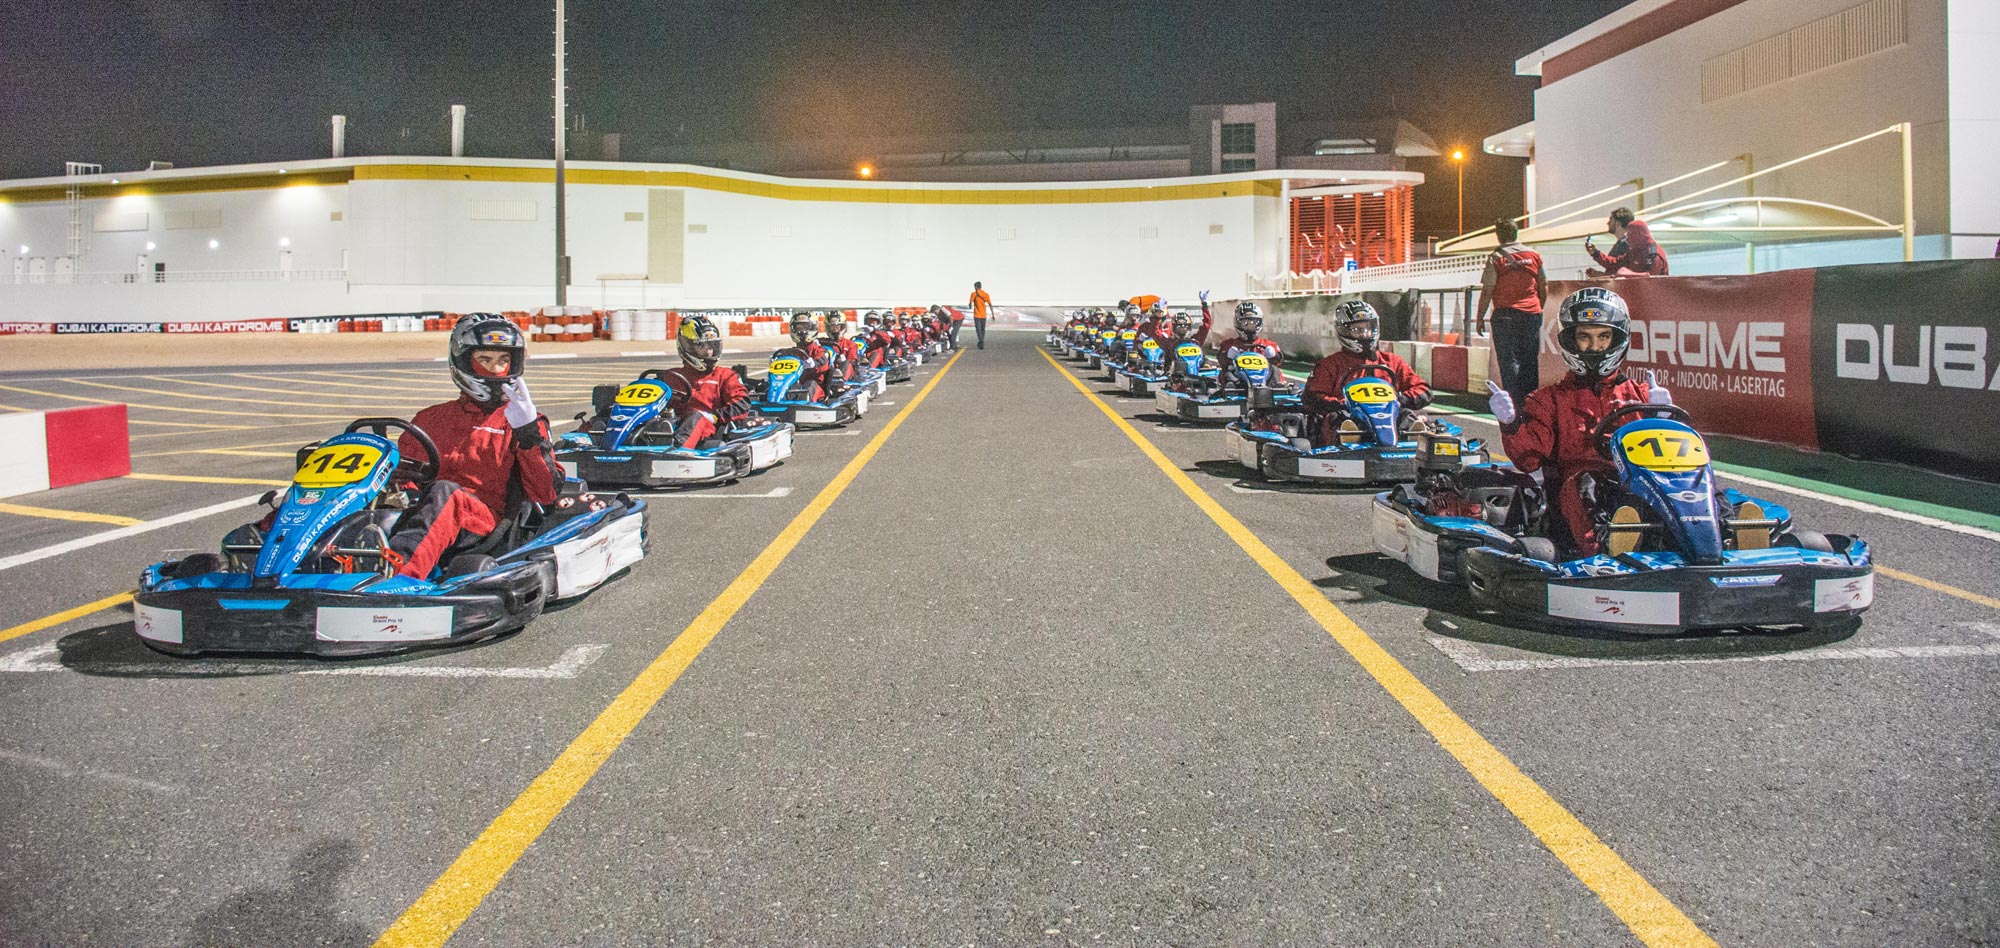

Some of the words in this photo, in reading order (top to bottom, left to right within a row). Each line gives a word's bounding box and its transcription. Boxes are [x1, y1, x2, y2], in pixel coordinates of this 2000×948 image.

[57, 323, 89, 333] DUBAI
[91, 323, 161, 333] KARTDROME
[168, 323, 203, 333] DUBAI
[205, 321, 283, 332] KARTDROME
[1540, 318, 1786, 373] KDROME
[1241, 358, 1263, 366] 03
[1837, 323, 2000, 391] DUB
[773, 362, 795, 371] 05
[1626, 366, 1668, 386] OUTOR
[1677, 371, 1718, 391] INDOOR
[1727, 375, 1785, 397] LASERTAG
[623, 388, 654, 399] 16
[1356, 387, 1389, 398] 18
[1638, 437, 1690, 458] 17
[313, 453, 365, 474] 14
[292, 534, 313, 563] DUBAI
[312, 491, 358, 537] KARTDROME
